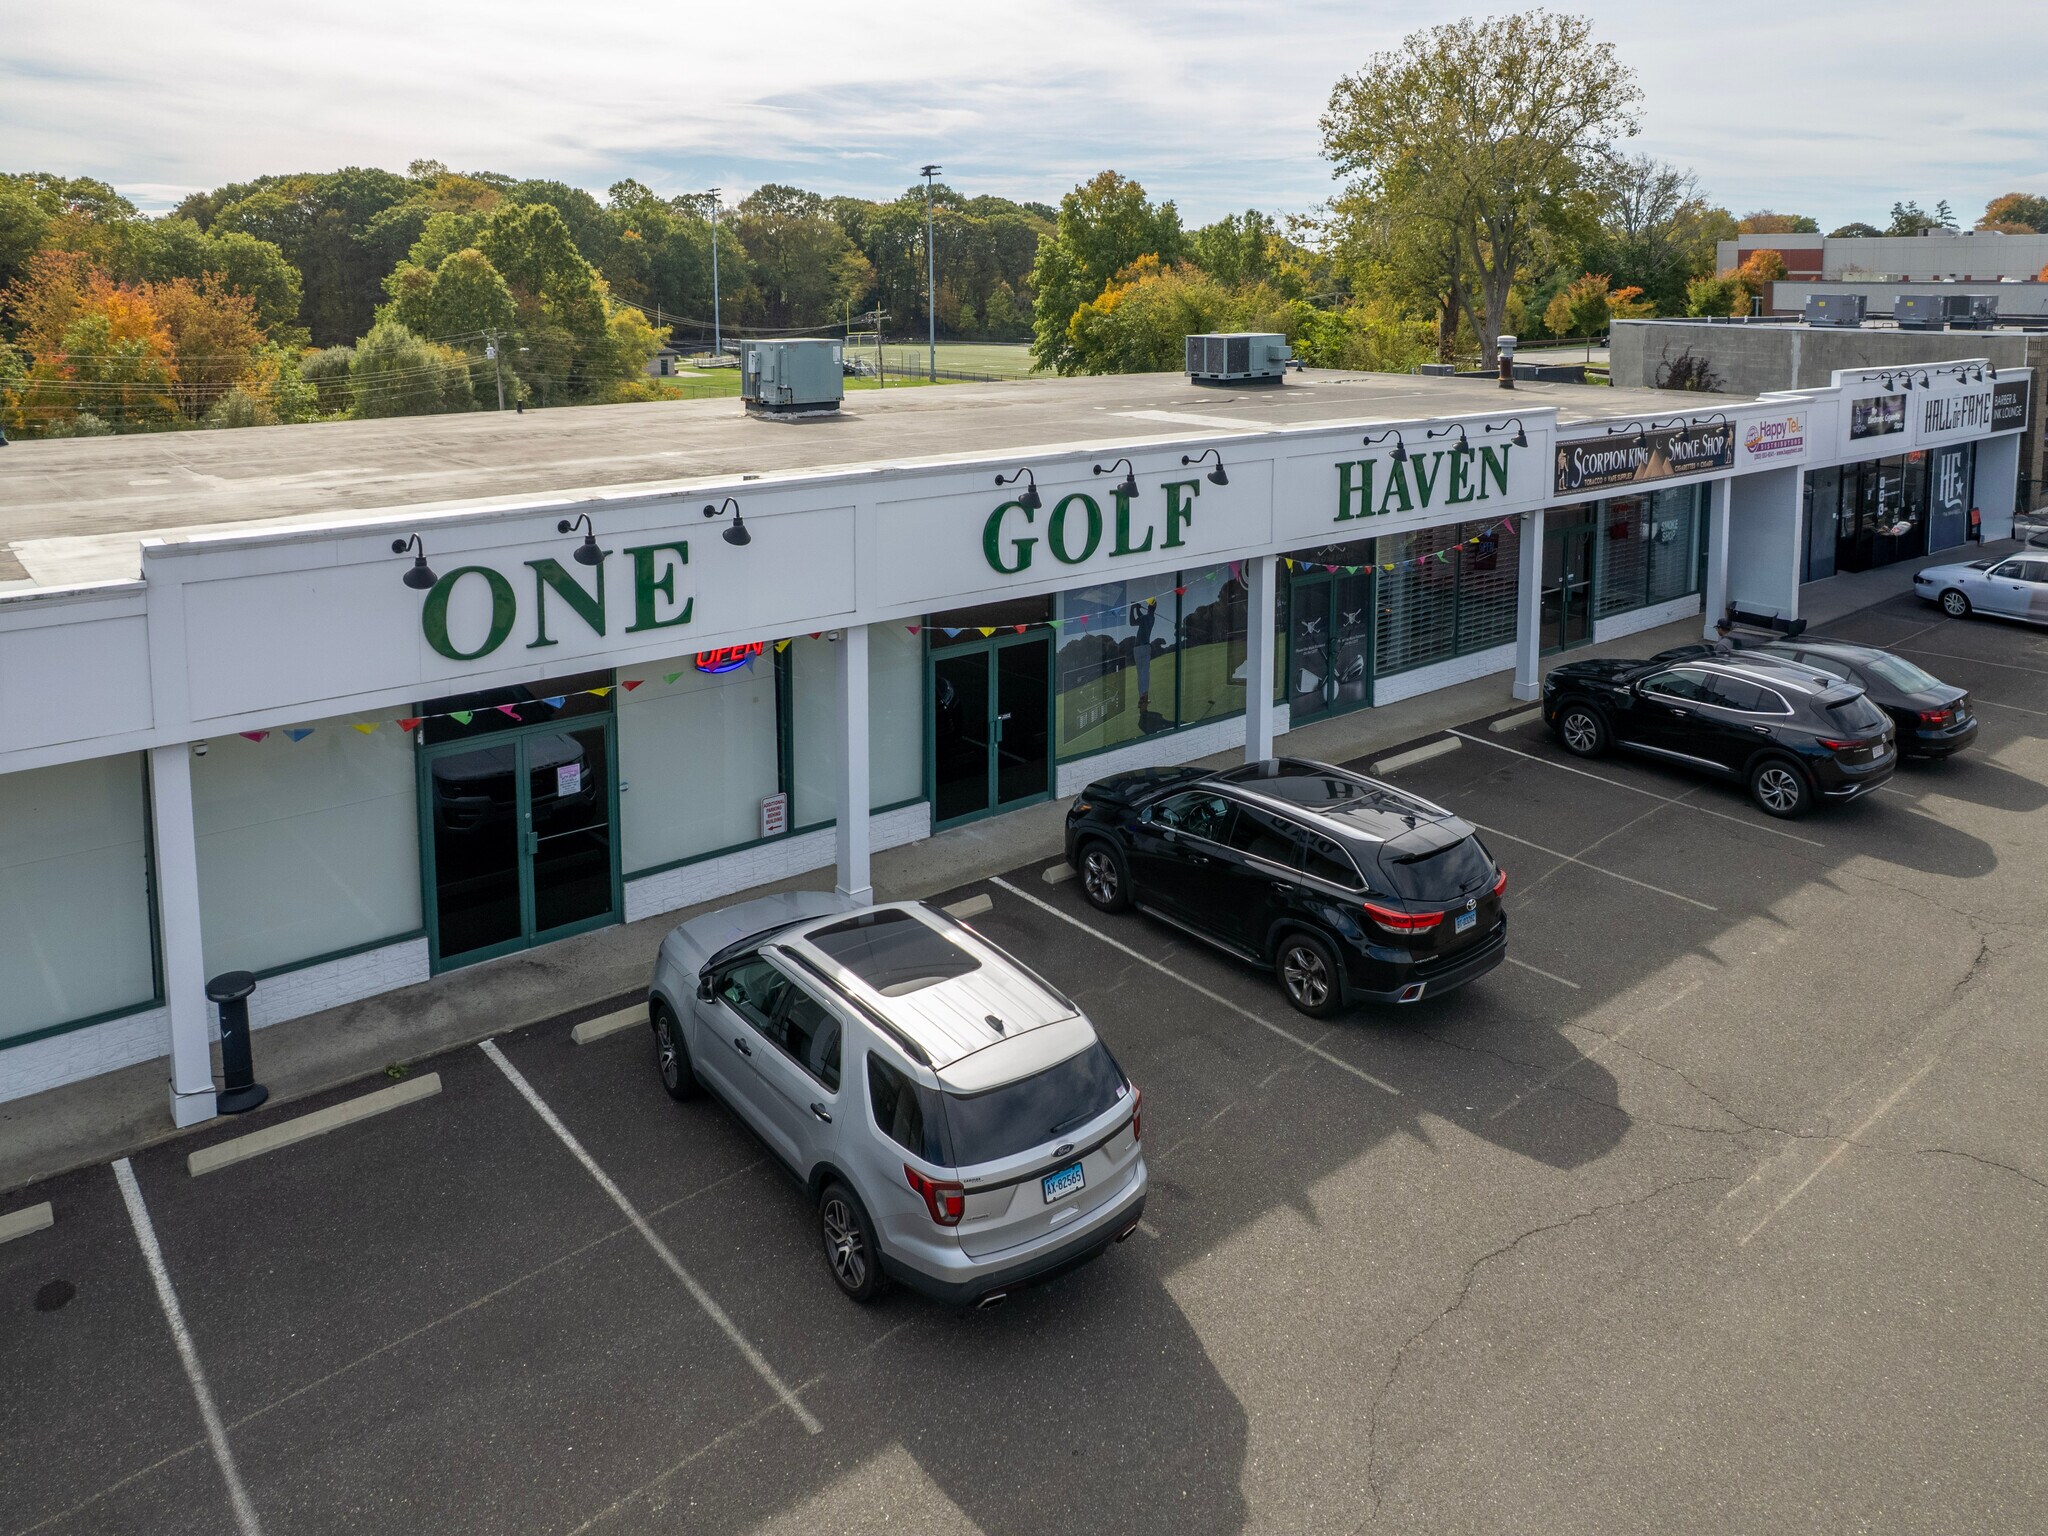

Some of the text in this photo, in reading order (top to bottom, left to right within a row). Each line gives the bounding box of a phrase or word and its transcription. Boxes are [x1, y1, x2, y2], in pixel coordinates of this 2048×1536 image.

[1994, 393, 2017, 406] BARBER &
[1924, 398, 1952, 433] HALL
[1961, 392, 1991, 429] FAME
[1993, 405, 2023, 420] INK LOUNGE
[1760, 420, 1787, 440] Happy
[1668, 433, 1724, 462] SMOKE SHOP
[1760, 437, 1802, 451] DISTRIBUTORS
[1571, 446, 1649, 488] SCORPION KING
[1674, 462, 1696, 472] CIGARETTES
[1584, 476, 1603, 486] TOBACCO
[422, 443, 1513, 660] ONE GOLF HAVEN
[696, 641, 764, 667] OPEN
[763, 799, 785, 808] ADDITIONAL
[766, 805, 782, 813] PARKING
[766, 817, 783, 825] BUILDING
[767, 811, 781, 819] BEHIND
